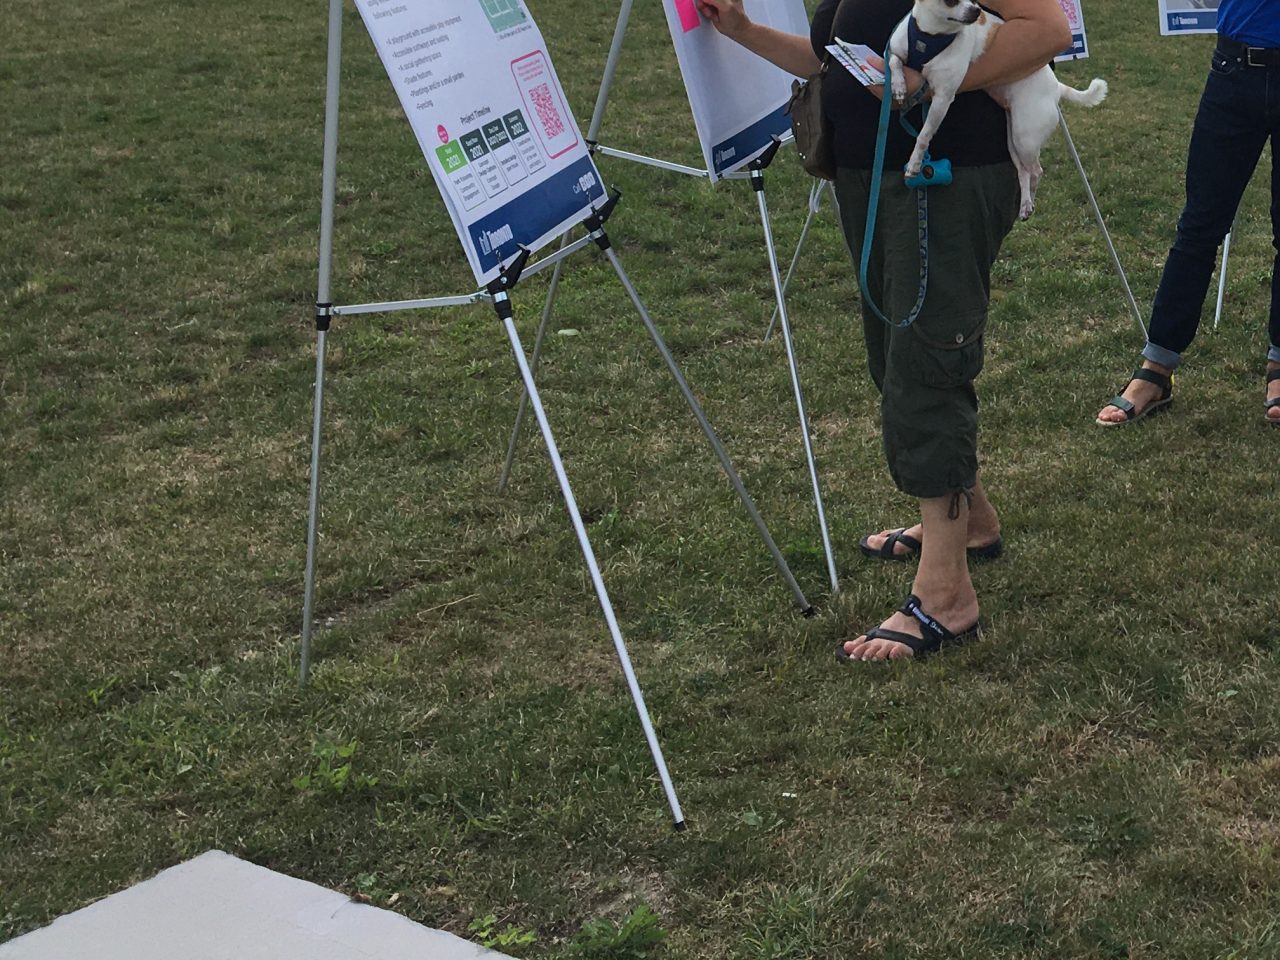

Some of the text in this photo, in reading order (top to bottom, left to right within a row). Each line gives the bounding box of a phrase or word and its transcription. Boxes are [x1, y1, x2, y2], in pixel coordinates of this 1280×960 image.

[460, 107, 491, 123] Project Timeline
[511, 122, 524, 135] 2022
[470, 145, 484, 158] 2021
